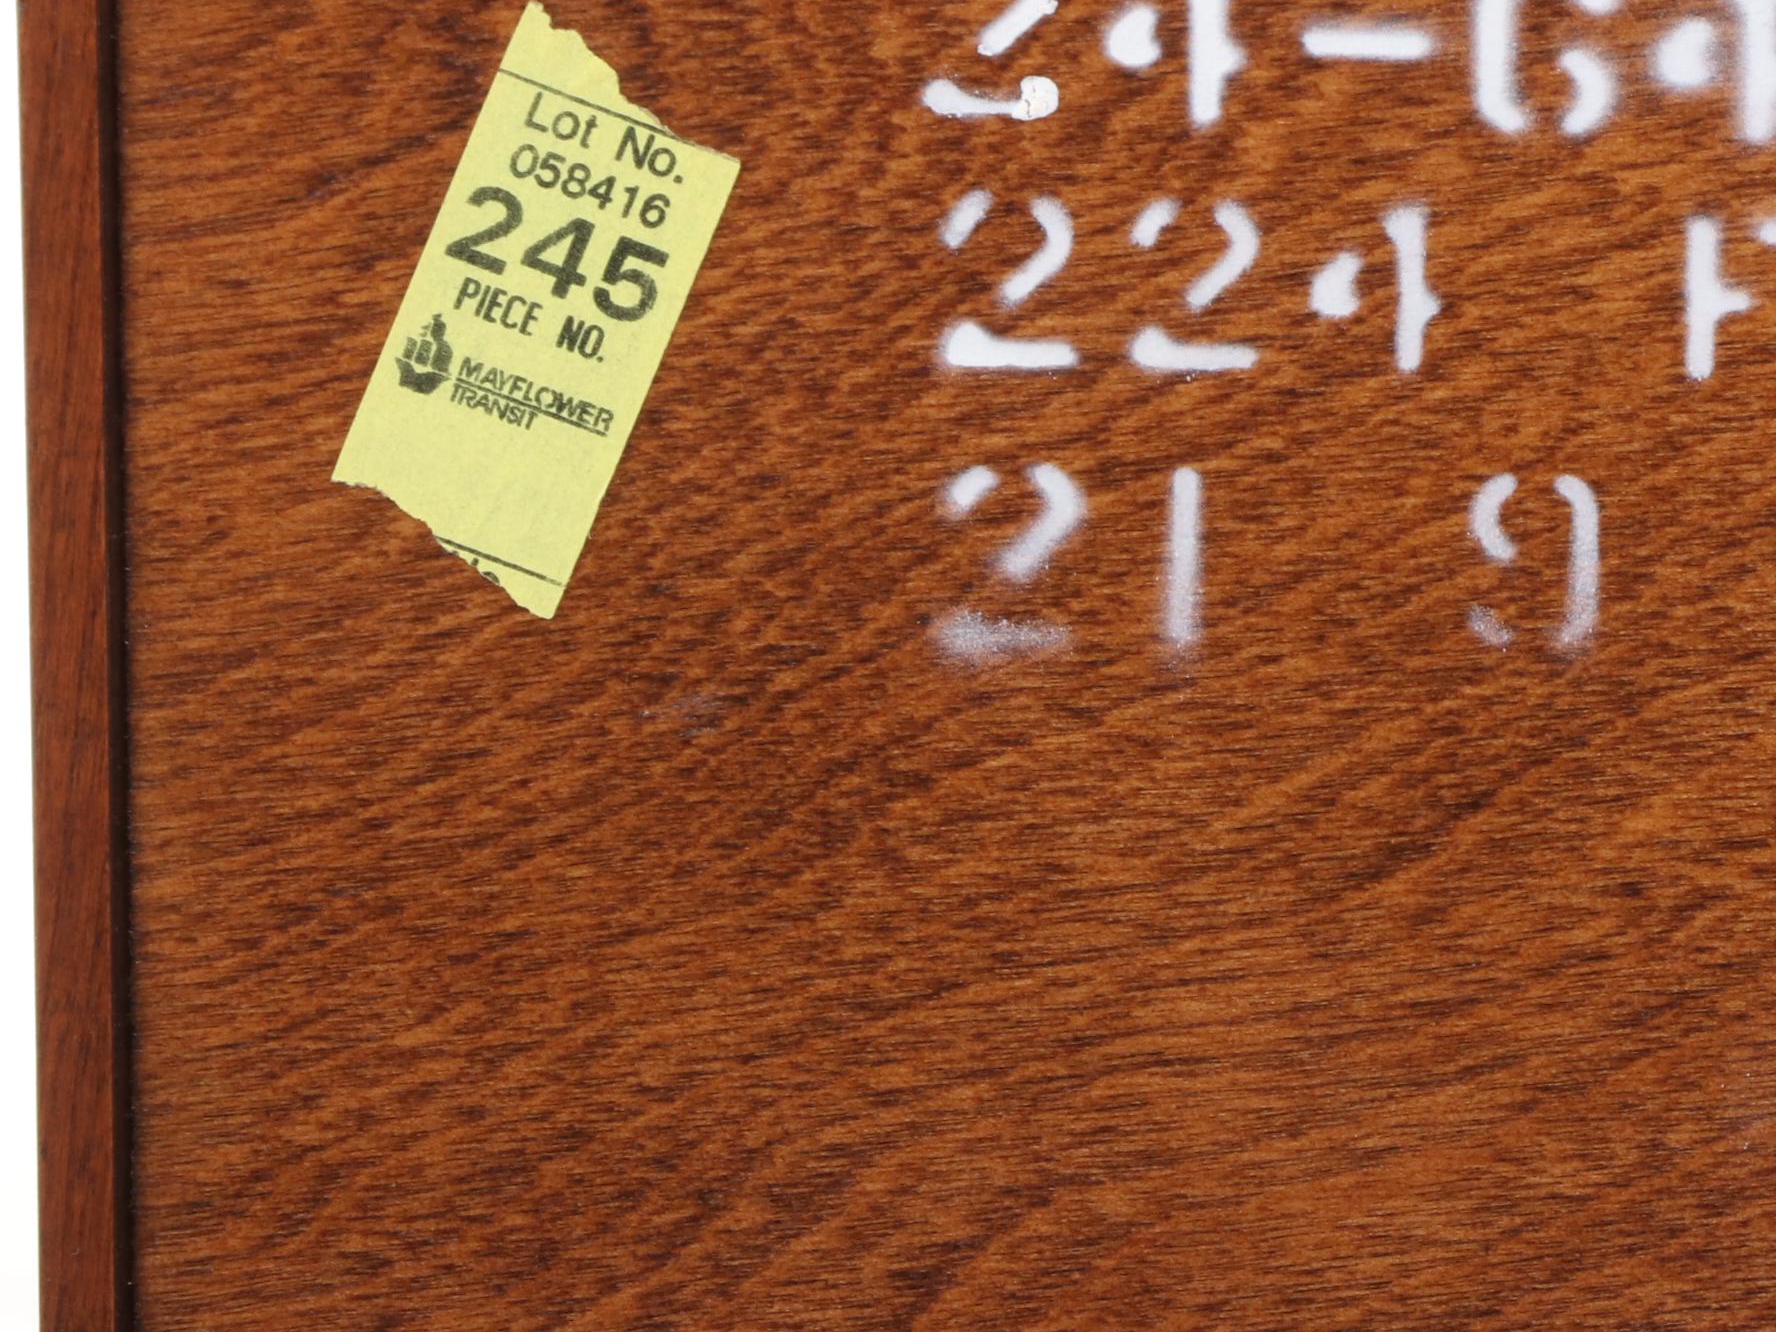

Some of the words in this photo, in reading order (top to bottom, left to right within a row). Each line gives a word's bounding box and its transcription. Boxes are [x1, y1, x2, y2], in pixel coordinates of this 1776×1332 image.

[523, 91, 598, 148] Lot
[613, 128, 684, 184] No.
[509, 144, 671, 229] 058416
[445, 185, 670, 323] 245
[936, 189, 1442, 374] 224
[453, 276, 544, 337] PIECE
[555, 315, 605, 363] NO.
[449, 382, 539, 430] TRANSIT
[457, 356, 615, 432] MAYFLOWER
[936, 463, 1204, 657] 21
[1468, 472, 1602, 651] 9
